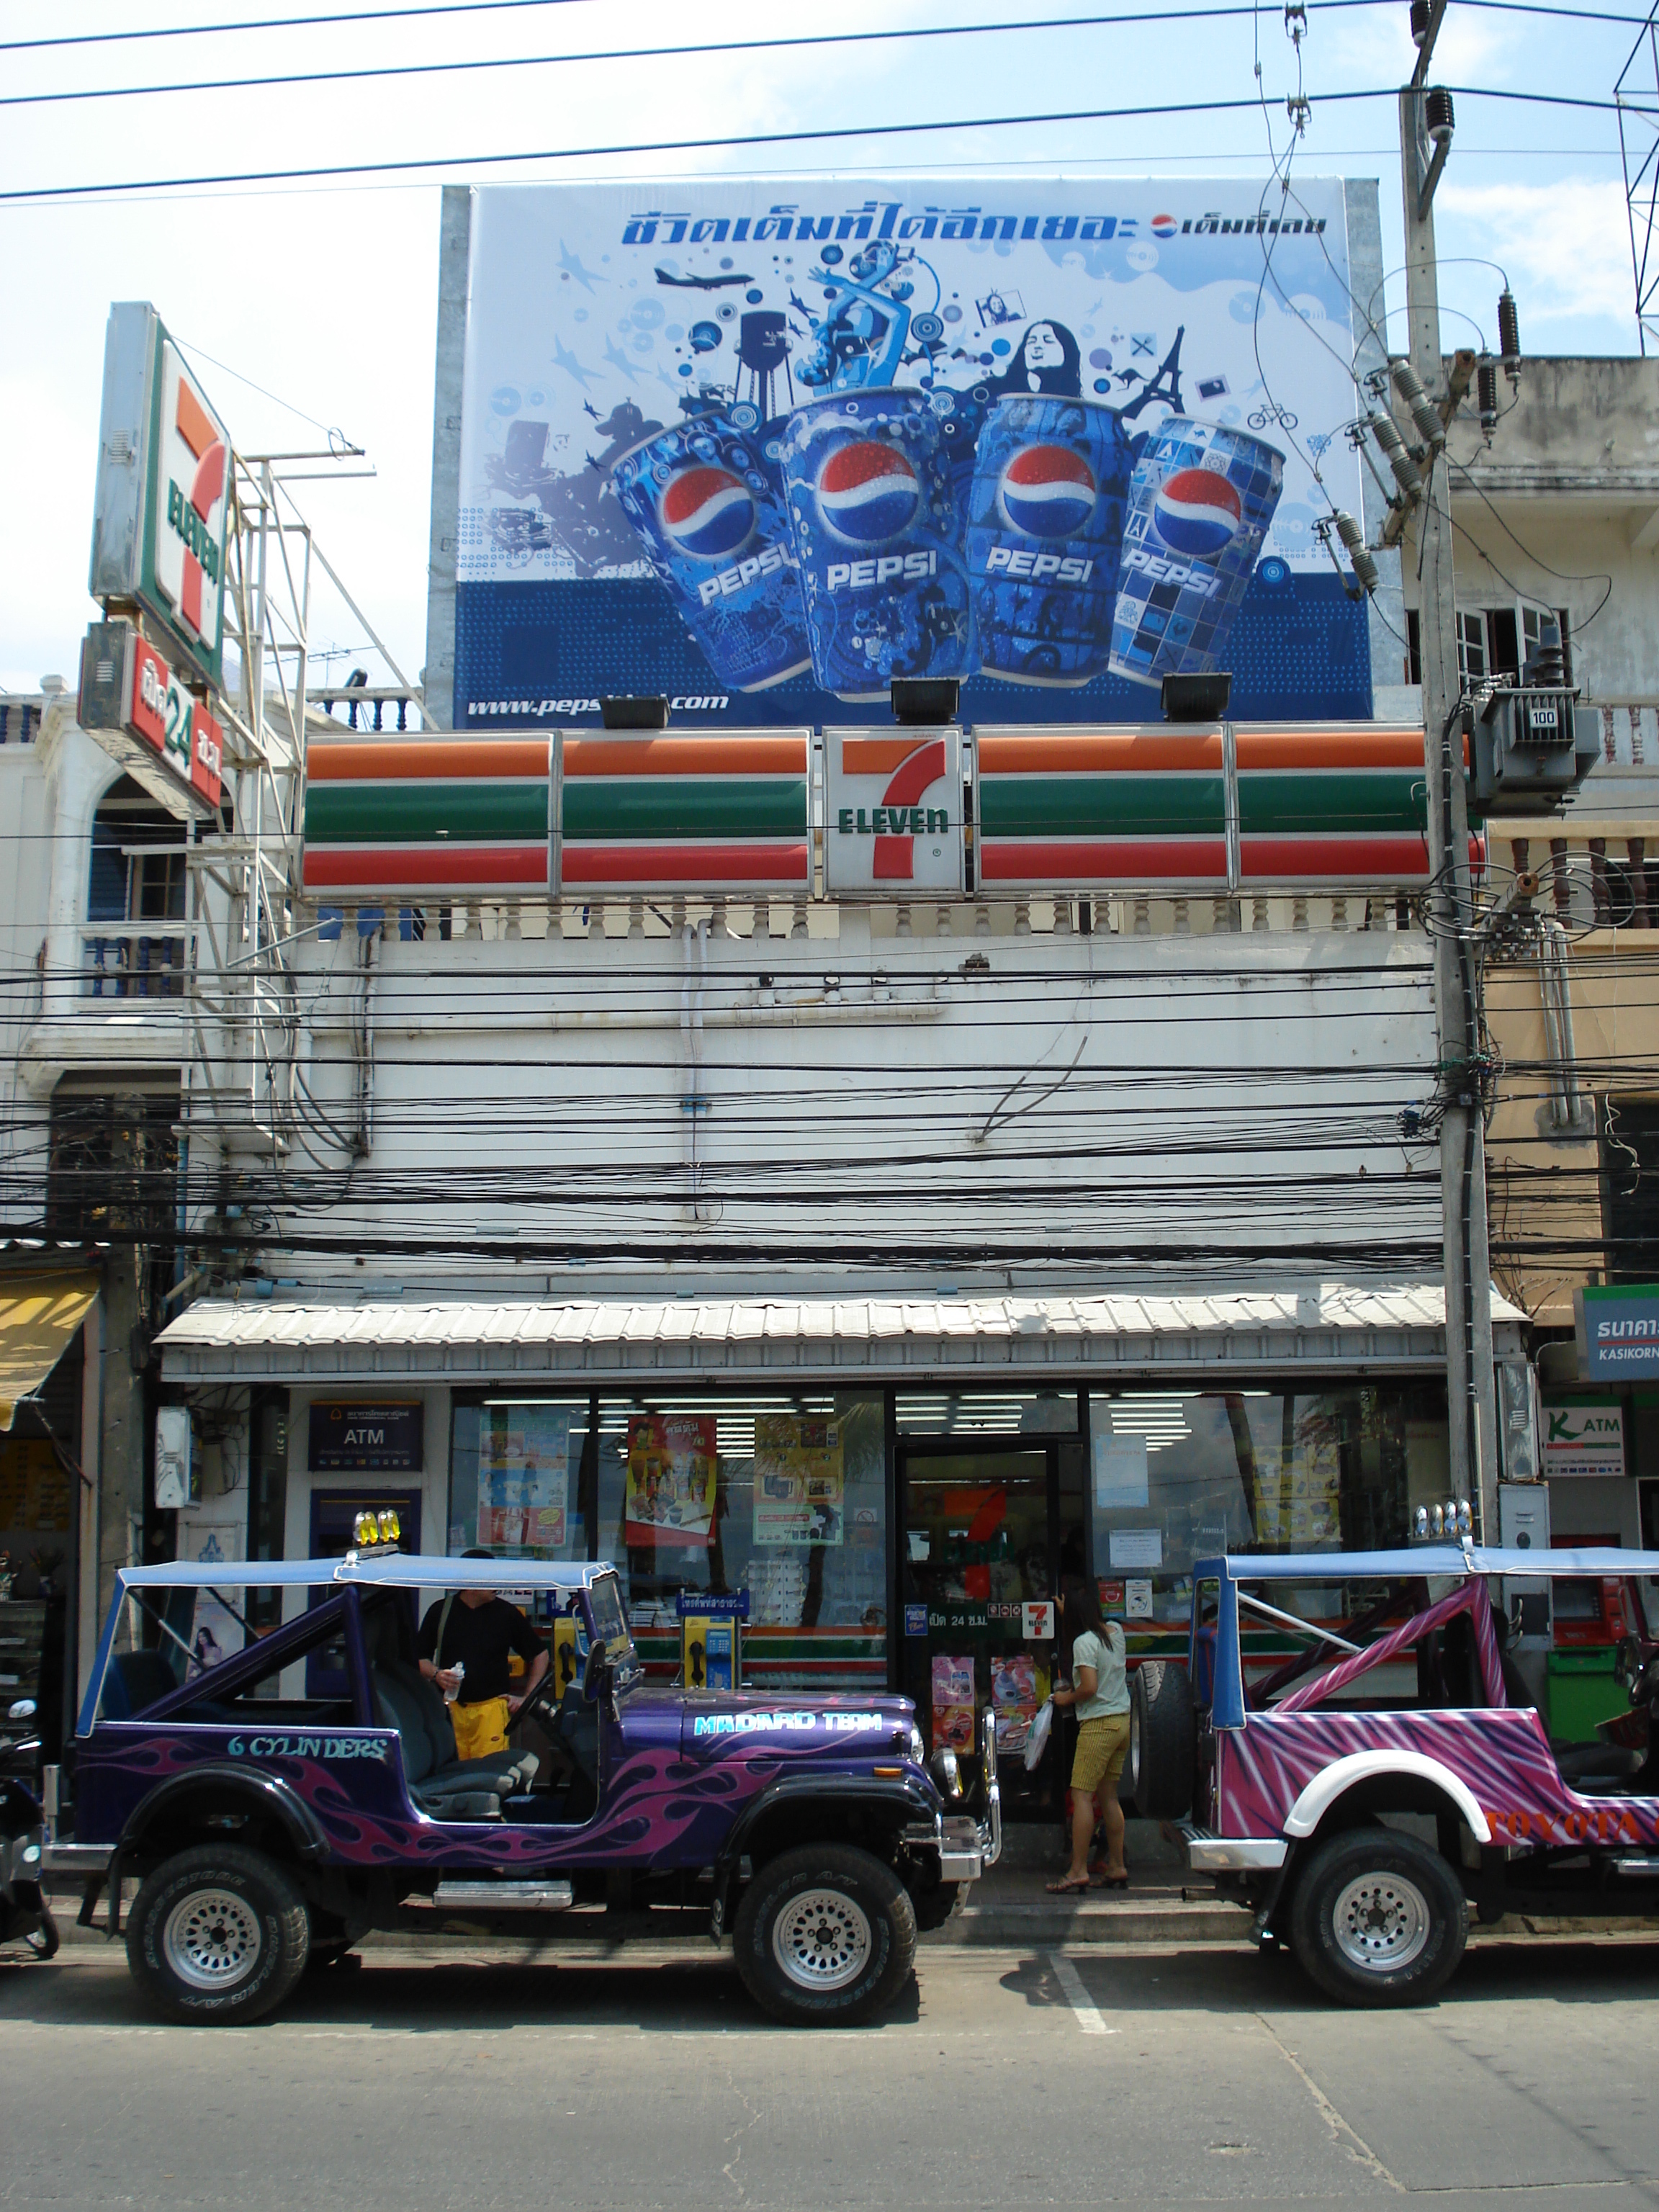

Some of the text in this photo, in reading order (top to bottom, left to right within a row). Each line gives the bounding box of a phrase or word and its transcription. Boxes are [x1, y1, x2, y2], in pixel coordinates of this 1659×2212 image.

[697, 542, 798, 606] PEPSI
[826, 549, 938, 593] PEPSI
[985, 547, 1094, 583] PEPSI
[1120, 548, 1222, 598] PEPSI
[165, 685, 192, 769] 24
[1532, 711, 1555, 724] 100
[842, 738, 947, 879] 7
[1597, 1319, 1659, 1338] ธนาคา
[343, 1429, 385, 1445] ATM
[1548, 1411, 1620, 1442] K ATM
[951, 1615, 964, 1626] 24
[1028, 1605, 1048, 1636] 7
[823, 1712, 883, 1732] TEAM
[228, 1735, 243, 1756] 6
[1484, 1811, 1642, 1841] TOYOTA
